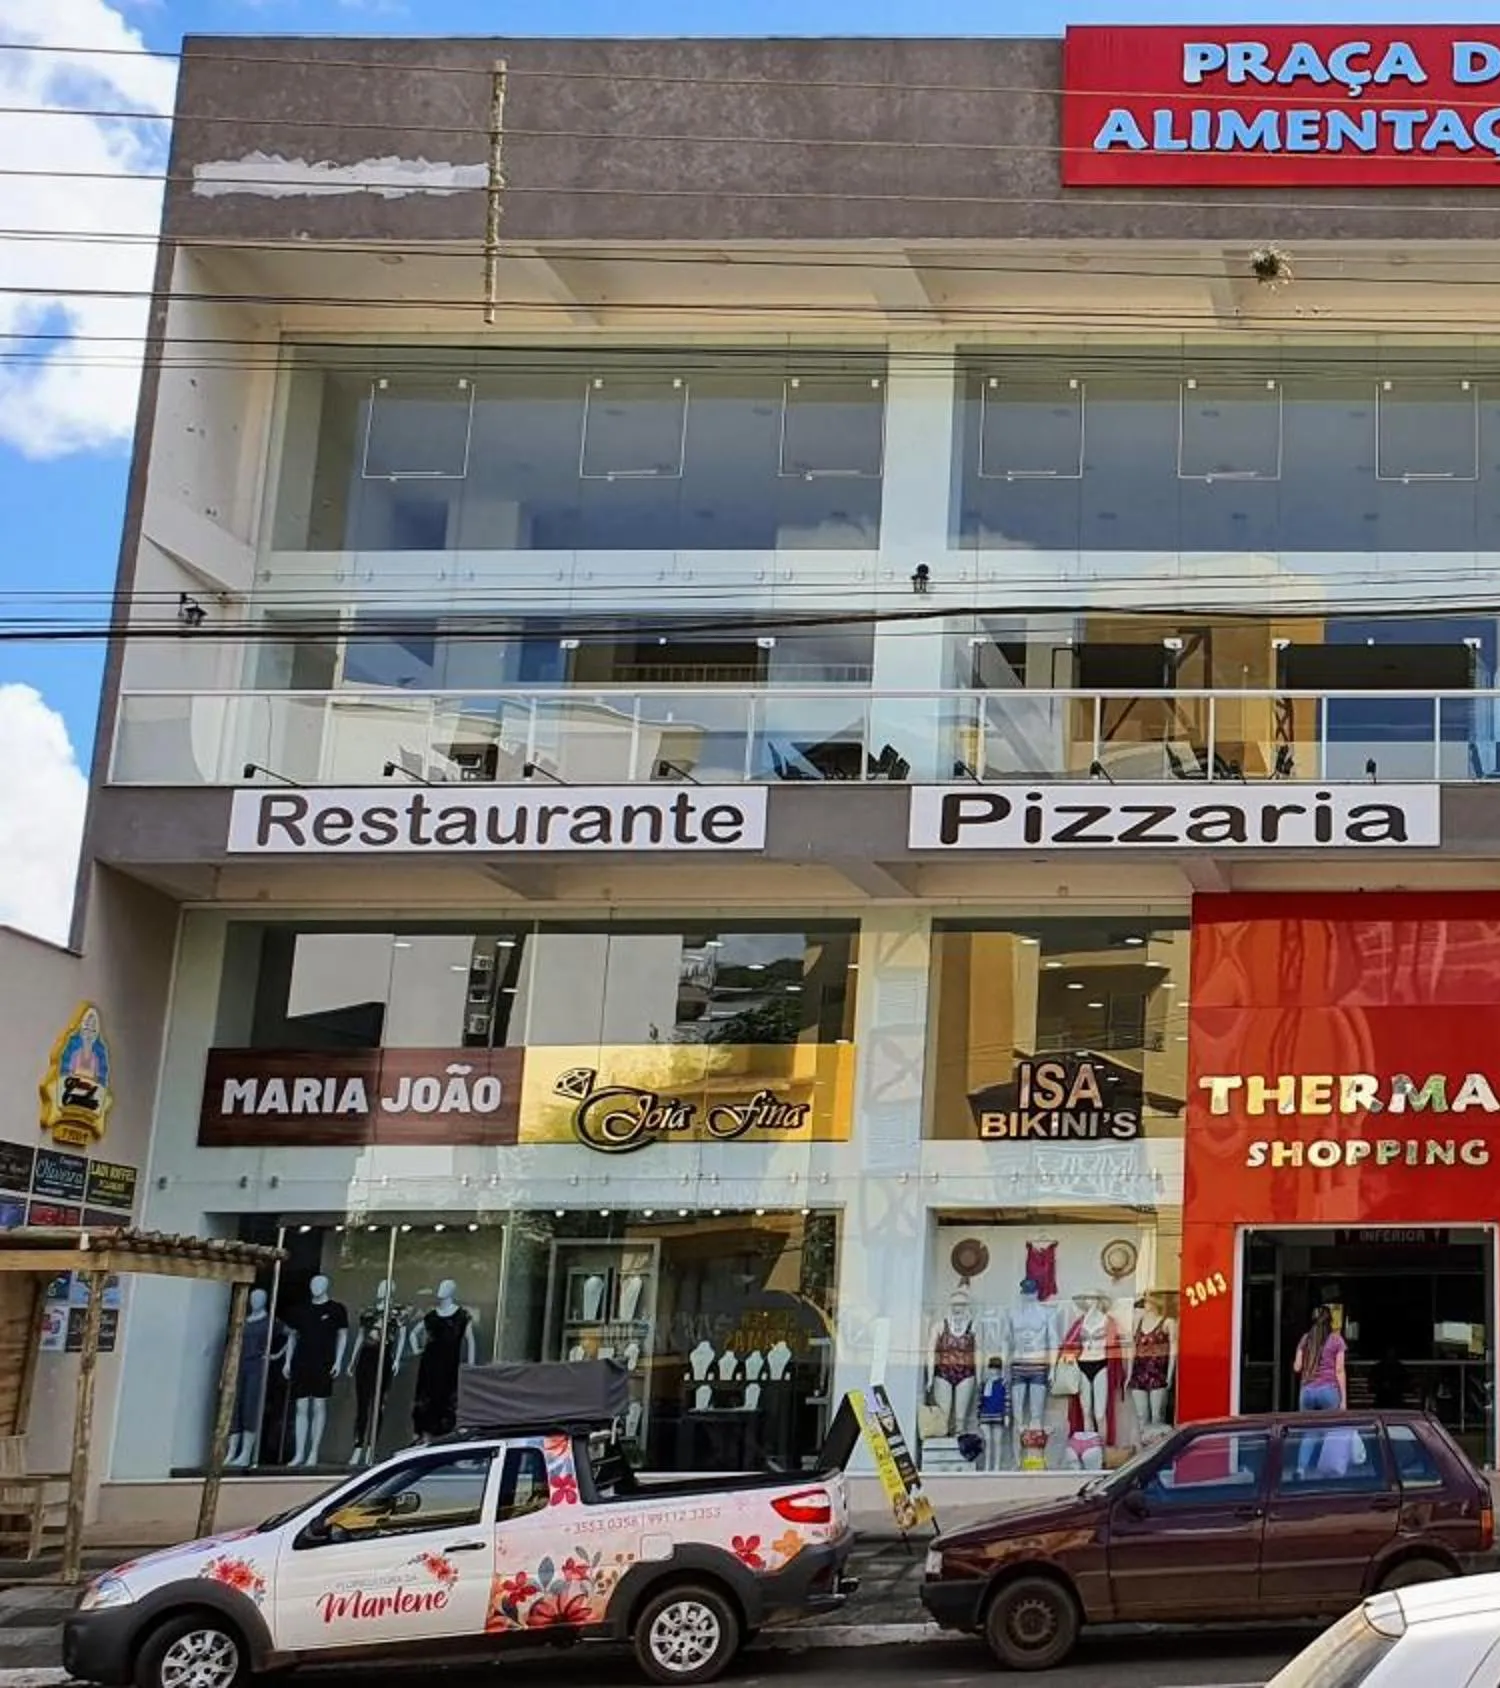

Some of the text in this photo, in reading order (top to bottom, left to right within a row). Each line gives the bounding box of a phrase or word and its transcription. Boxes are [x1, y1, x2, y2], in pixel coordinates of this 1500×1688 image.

[1182, 41, 1428, 98] PRAÇA
[255, 793, 745, 847] Restaurante
[938, 791, 1409, 844] Pizzaria
[220, 1063, 502, 1115] MARIA JOÃO
[1018, 1062, 1104, 1110] ISA
[980, 1111, 1138, 1138] BIKINI'S
[1245, 1138, 1491, 1168] SHOPPING
[1358, 1230, 1426, 1244] INFERIOR
[1185, 1271, 1228, 1307] 2043
[315, 1585, 449, 1624] Marlene
